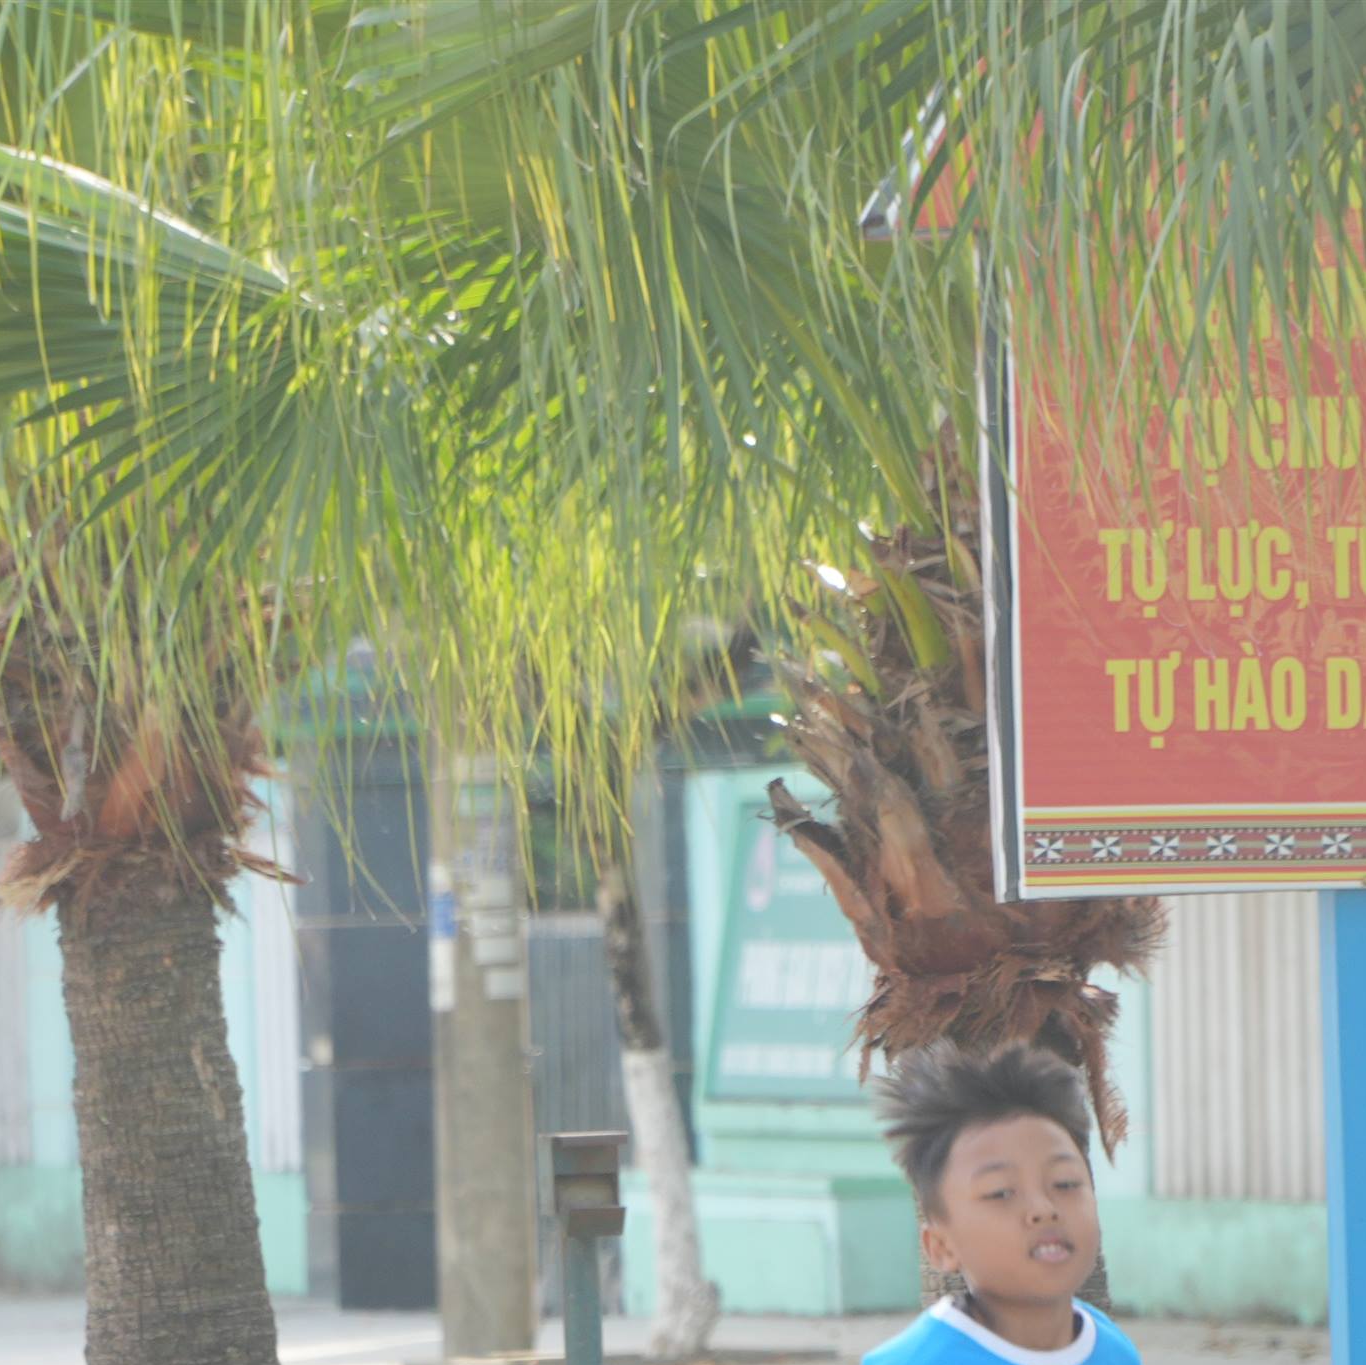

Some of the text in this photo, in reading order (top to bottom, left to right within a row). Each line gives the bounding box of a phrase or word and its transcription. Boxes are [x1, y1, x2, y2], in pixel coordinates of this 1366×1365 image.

[1098, 520, 1175, 619] TỰ
[1187, 517, 1309, 618] LỰC,
[1105, 651, 1181, 748] TỰ
[1193, 641, 1308, 732] HÀO
